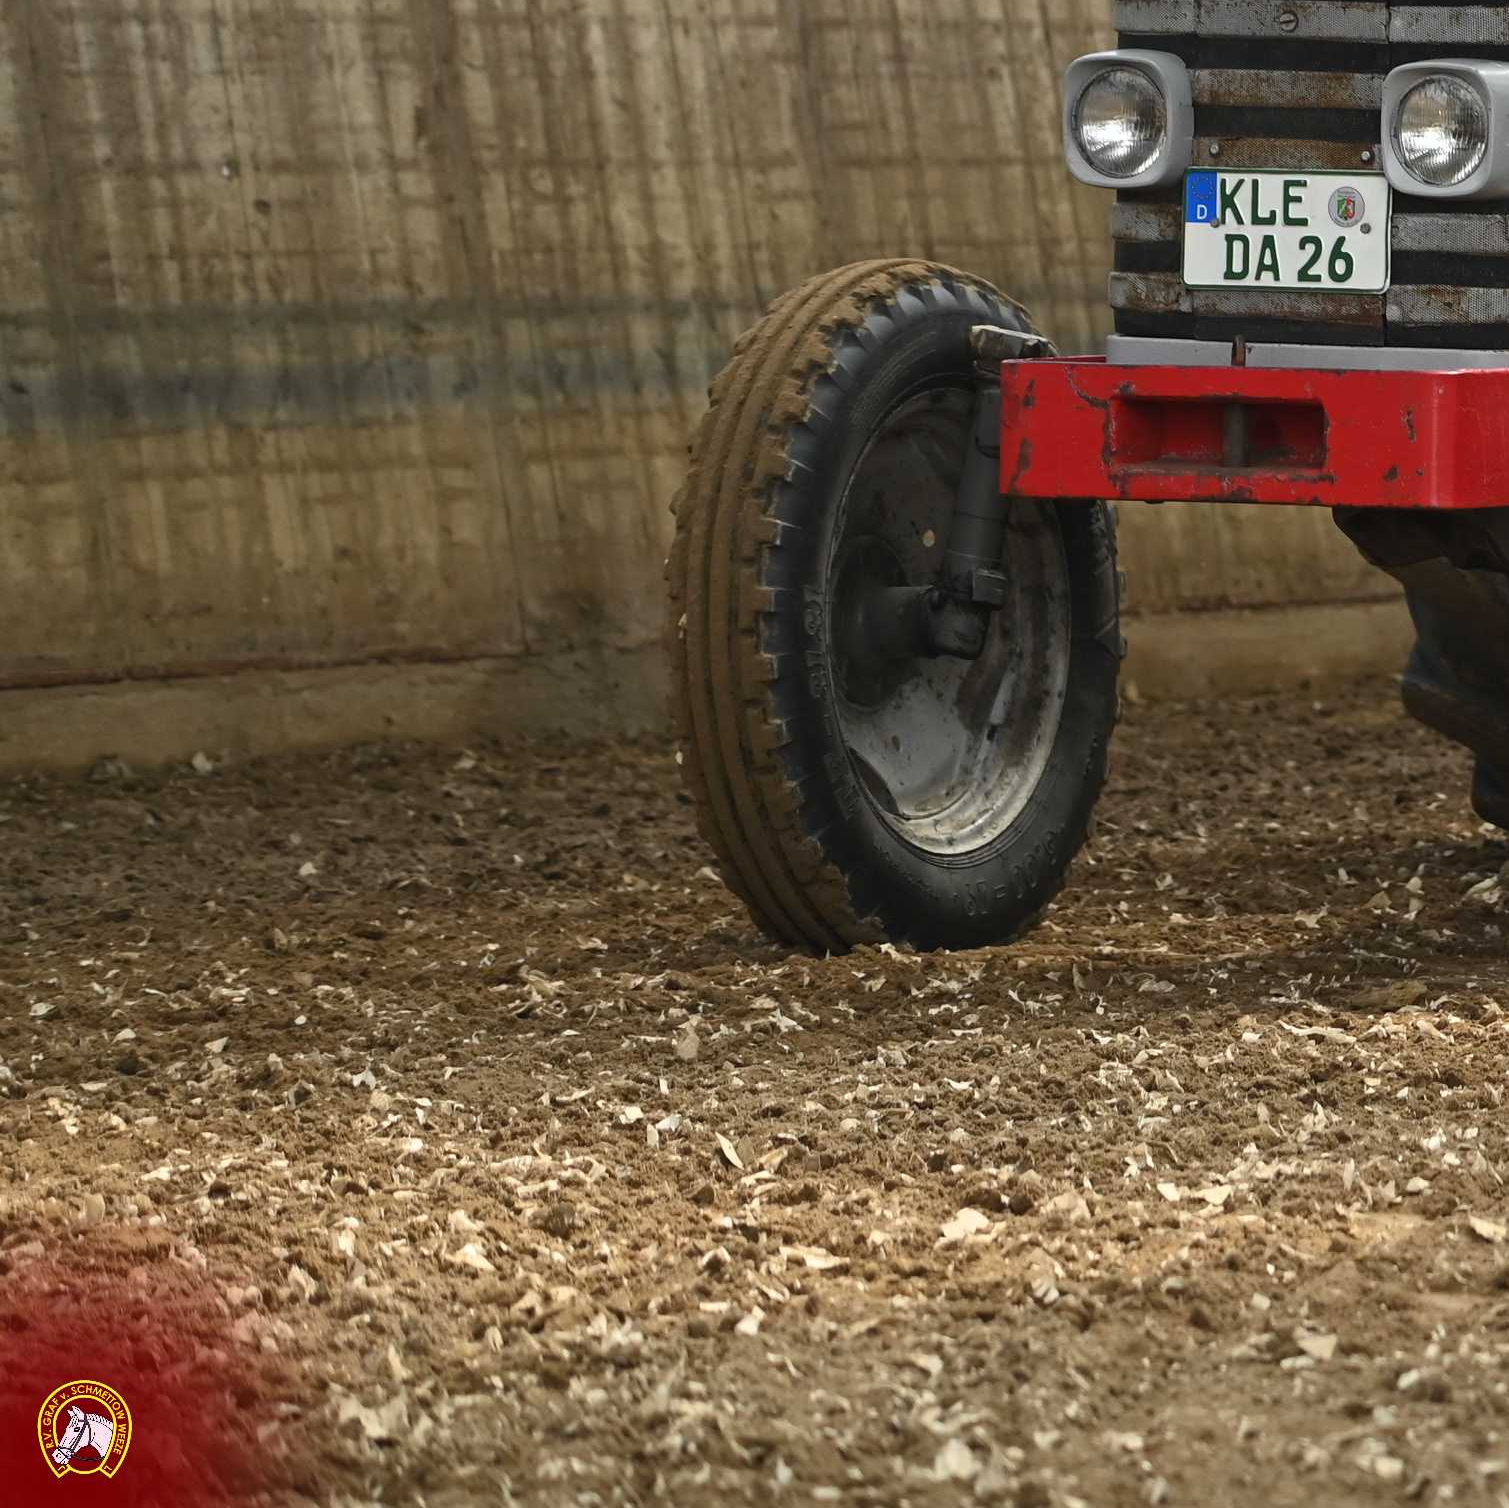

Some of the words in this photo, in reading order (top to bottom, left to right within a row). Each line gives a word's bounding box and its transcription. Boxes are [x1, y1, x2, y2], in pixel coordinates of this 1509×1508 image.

[1196, 204, 1207, 220] D
[1220, 178, 1309, 227] KLE
[1223, 234, 1281, 281] DA
[1297, 235, 1354, 283] 26
